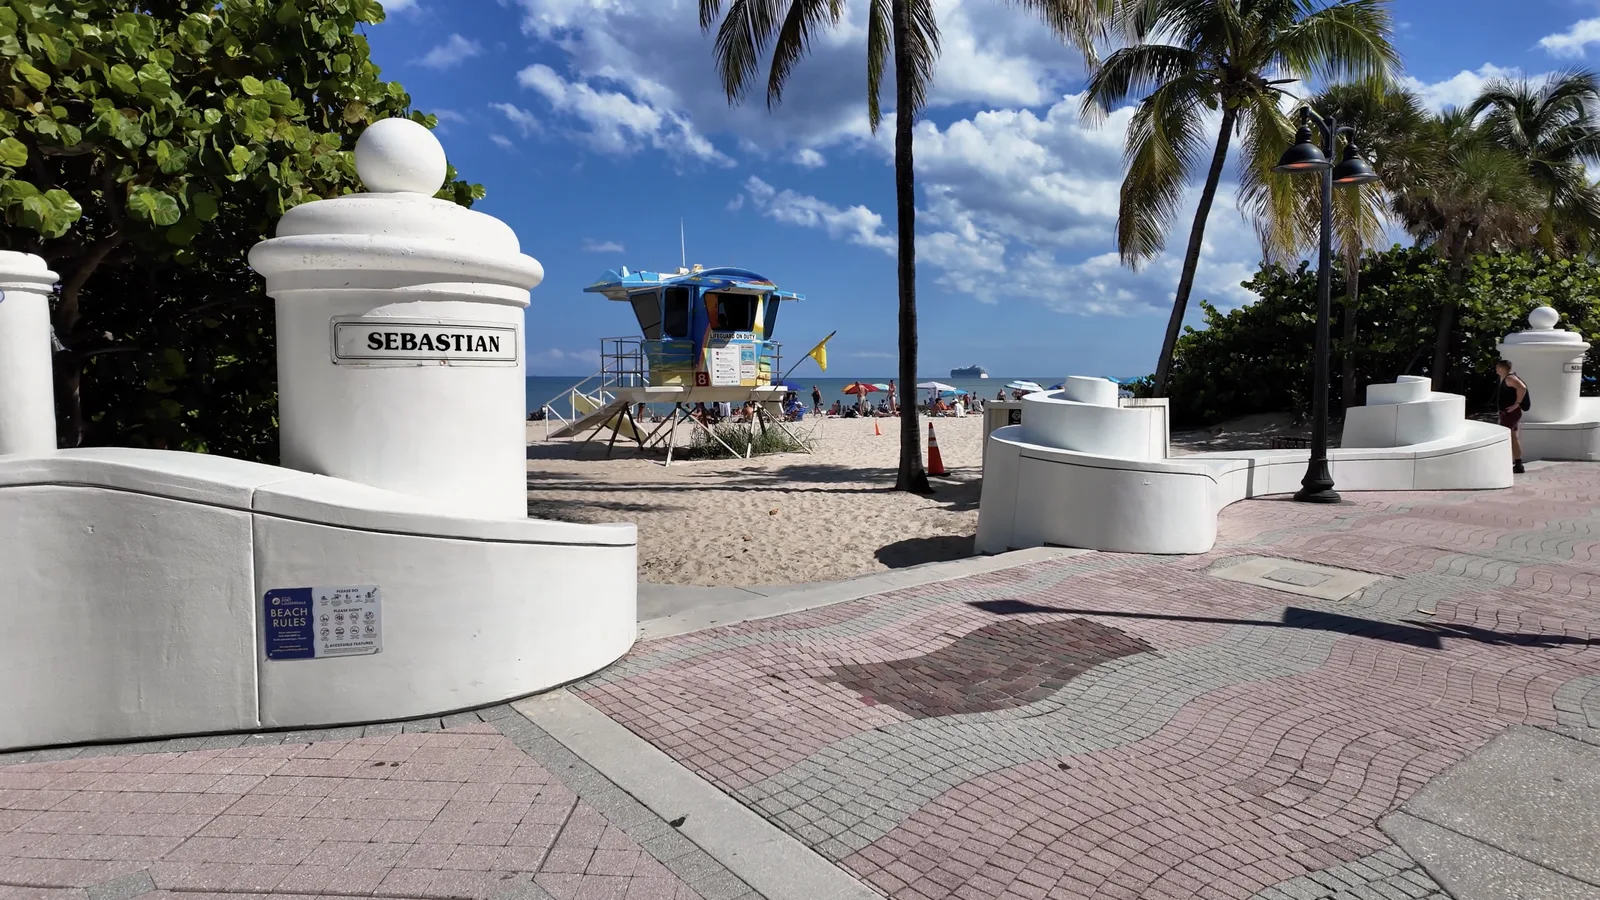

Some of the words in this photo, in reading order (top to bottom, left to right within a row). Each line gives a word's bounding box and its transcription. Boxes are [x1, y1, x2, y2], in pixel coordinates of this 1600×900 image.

[367, 332, 500, 352] SEBASTIAN
[698, 374, 706, 385] 8
[270, 607, 308, 618] BEACH
[273, 617, 306, 628] RULES
